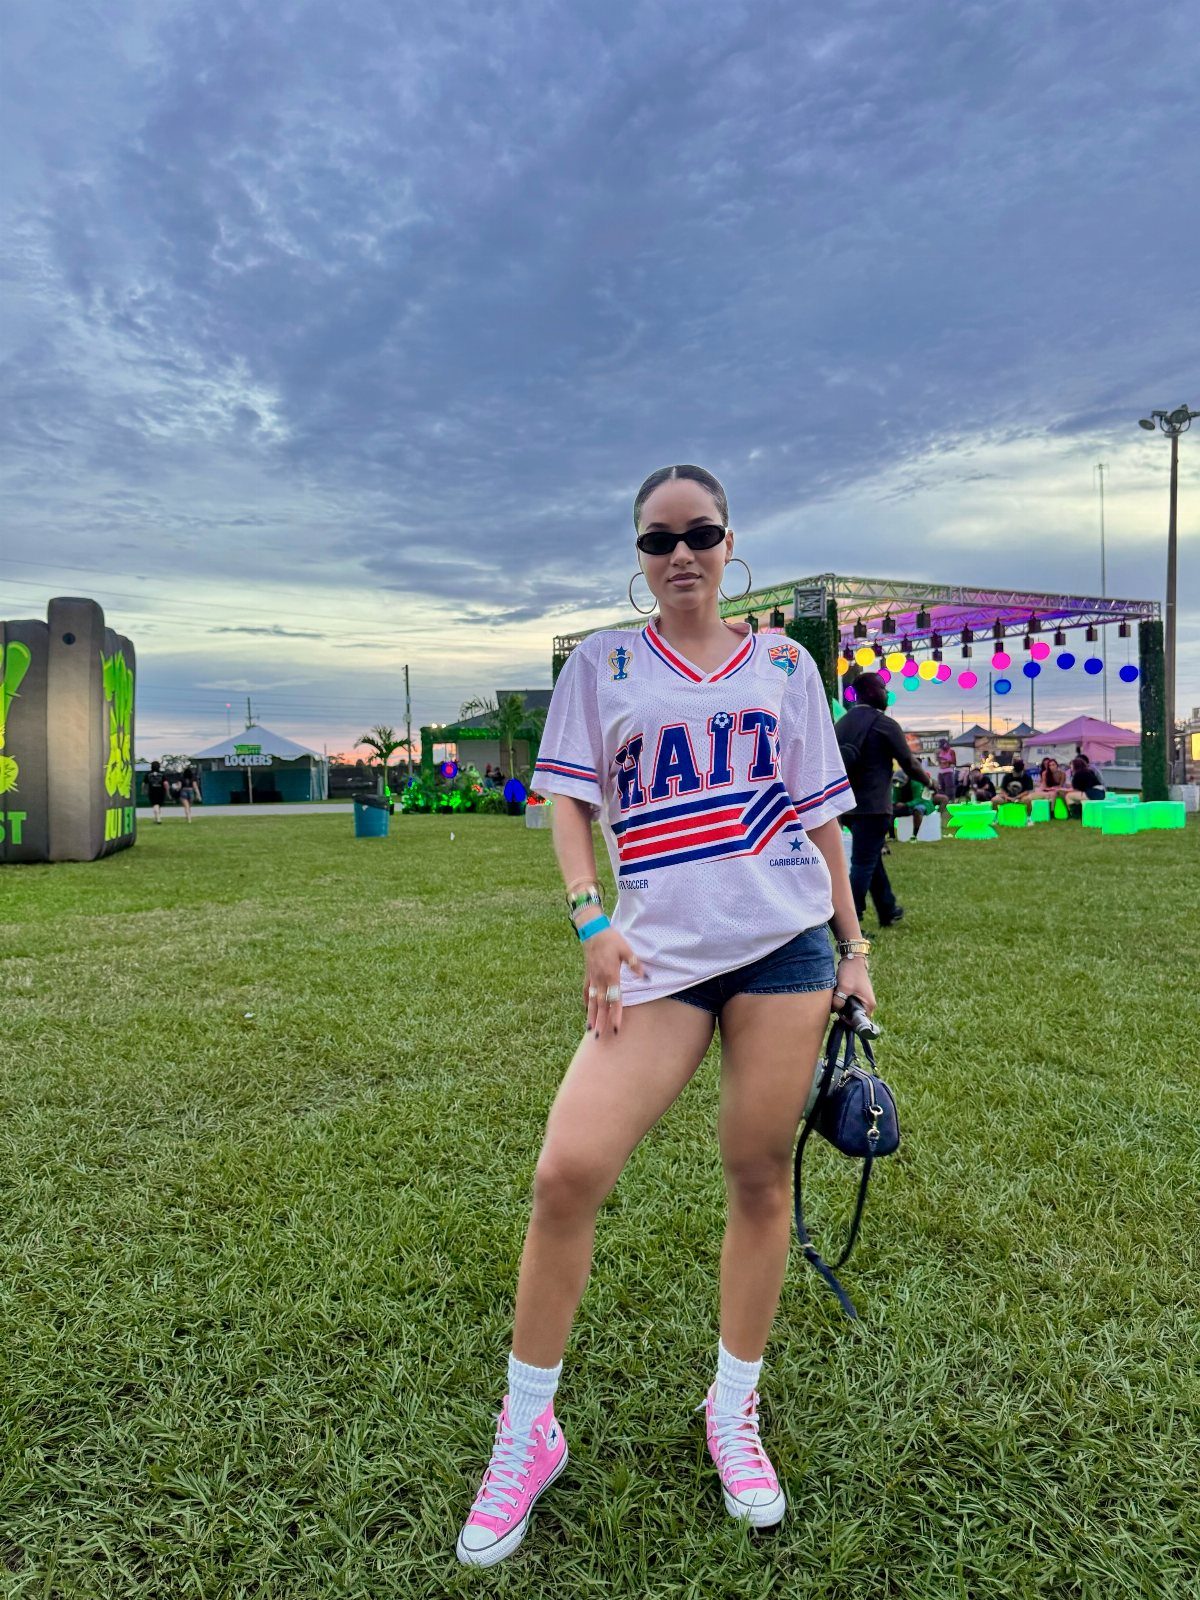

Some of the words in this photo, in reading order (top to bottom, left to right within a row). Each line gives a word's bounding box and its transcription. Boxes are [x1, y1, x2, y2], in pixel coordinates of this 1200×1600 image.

[224, 754, 273, 767] LOCKERS
[615, 708, 781, 813] HAIT
[769, 857, 810, 867] CARIBBEAN
